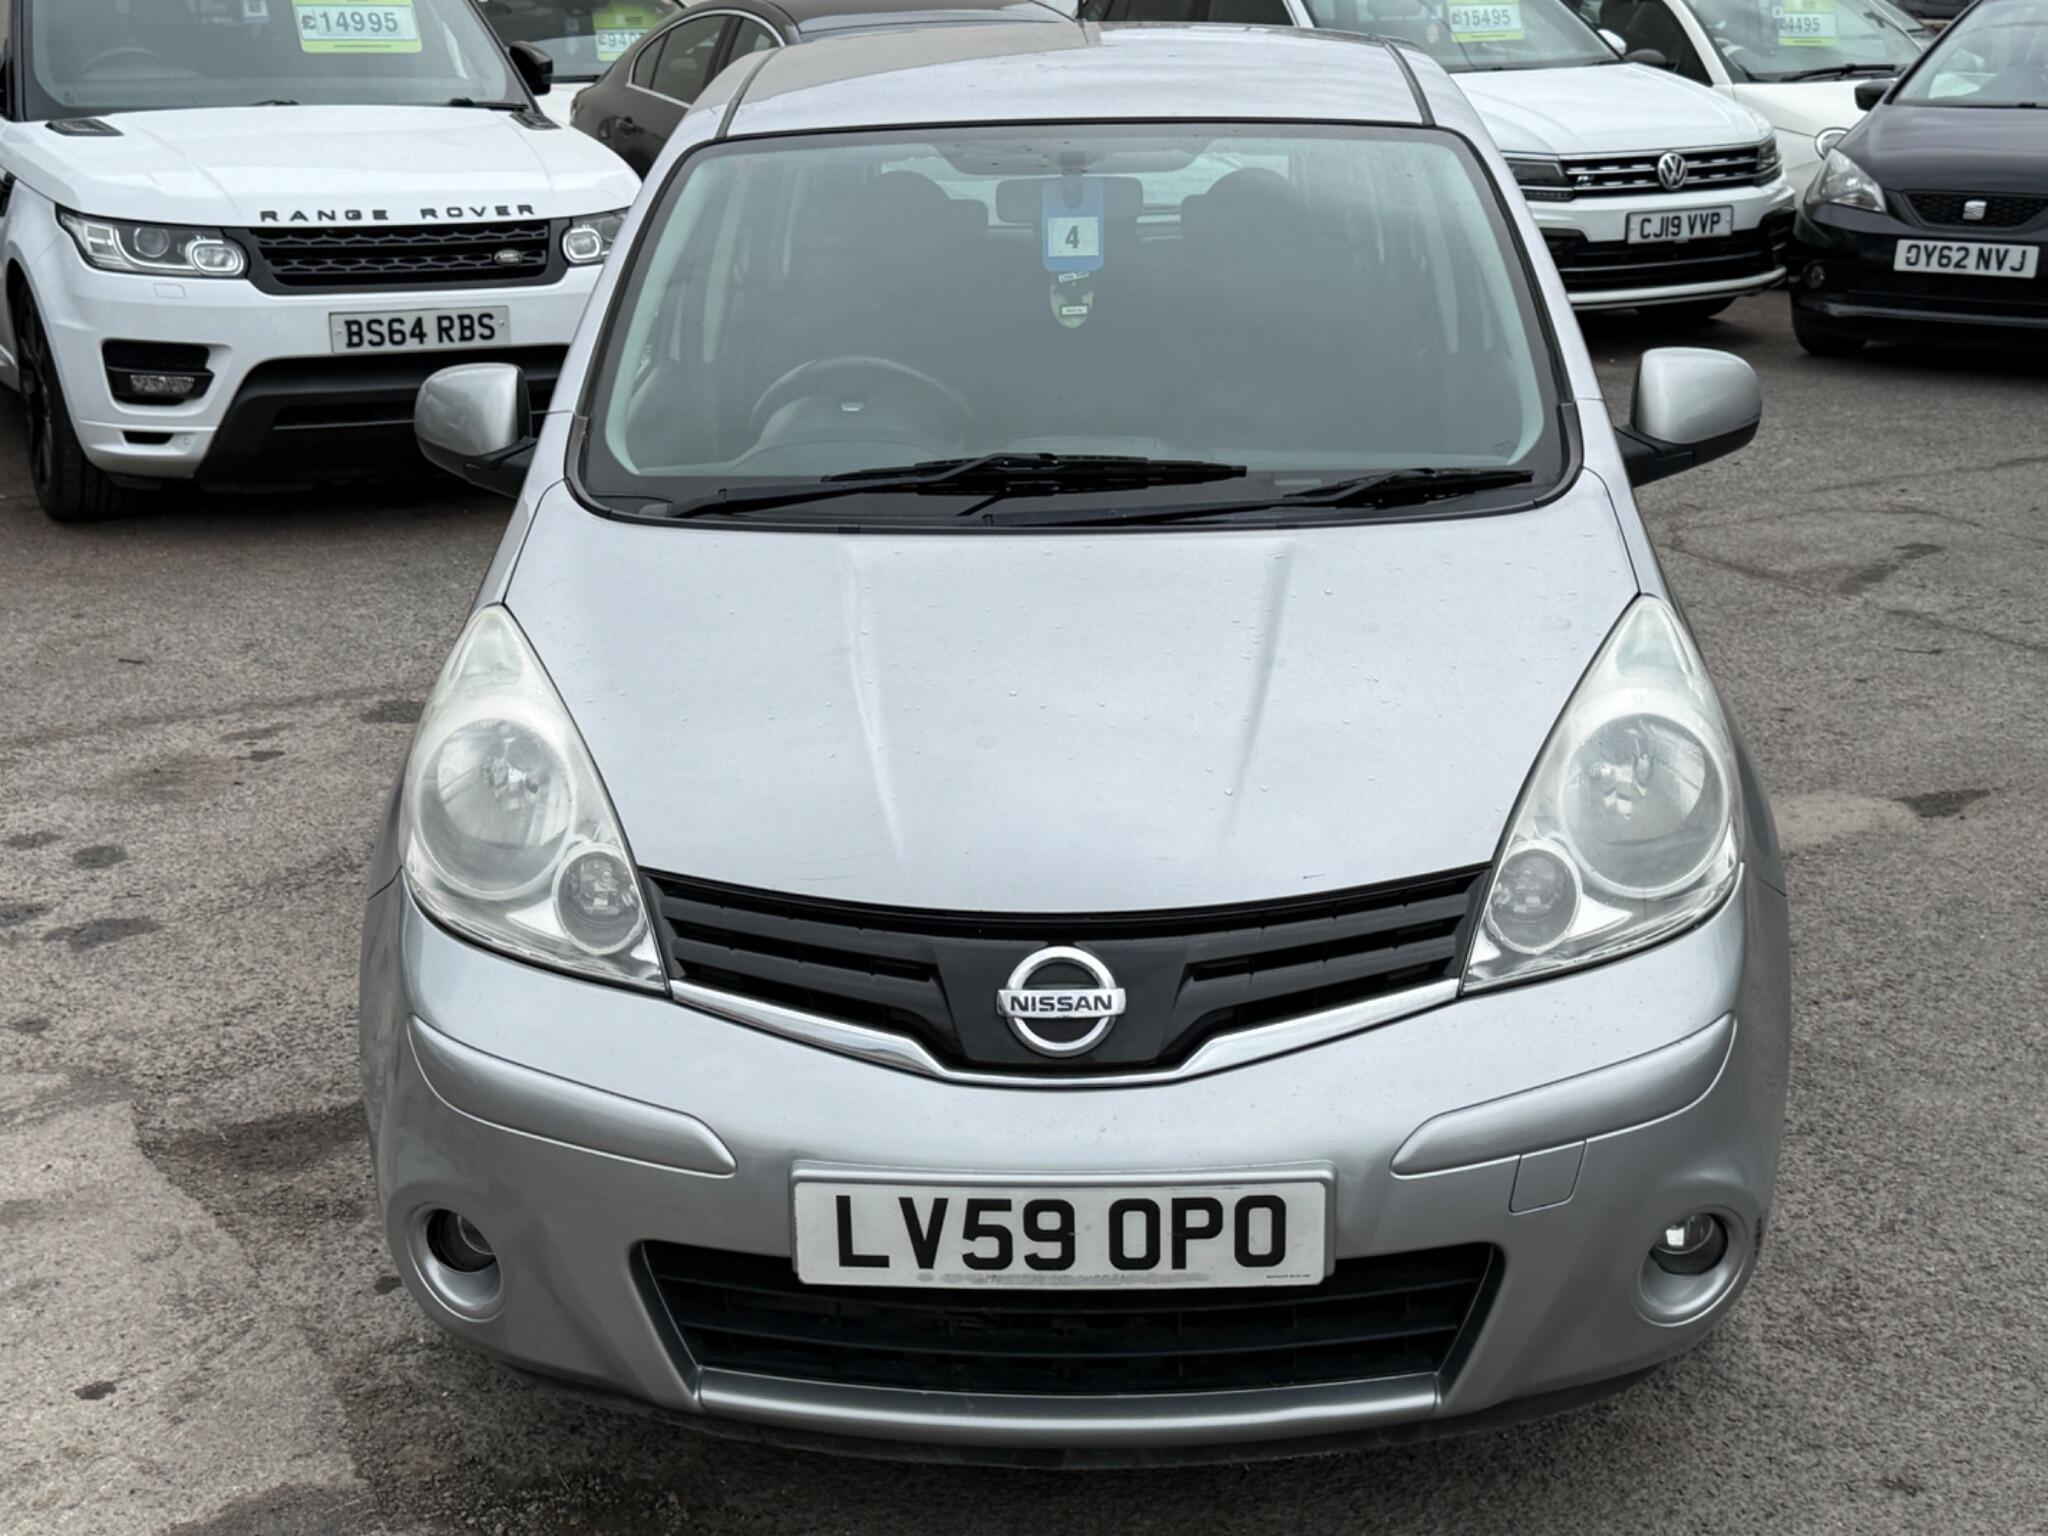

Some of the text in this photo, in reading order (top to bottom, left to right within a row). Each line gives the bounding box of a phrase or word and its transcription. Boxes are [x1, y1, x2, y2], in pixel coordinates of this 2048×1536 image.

[302, 11, 398, 32] £14995
[260, 204, 535, 222] RANGE ROVER
[1639, 212, 1721, 239] CJ19 VVP
[1065, 225, 1080, 249] 4
[1905, 243, 2027, 272] OY62 NVJ
[344, 313, 496, 348] BS64 RBS
[1009, 994, 1112, 1013] NISSAN
[835, 1194, 1287, 1271] LV59 OPO
